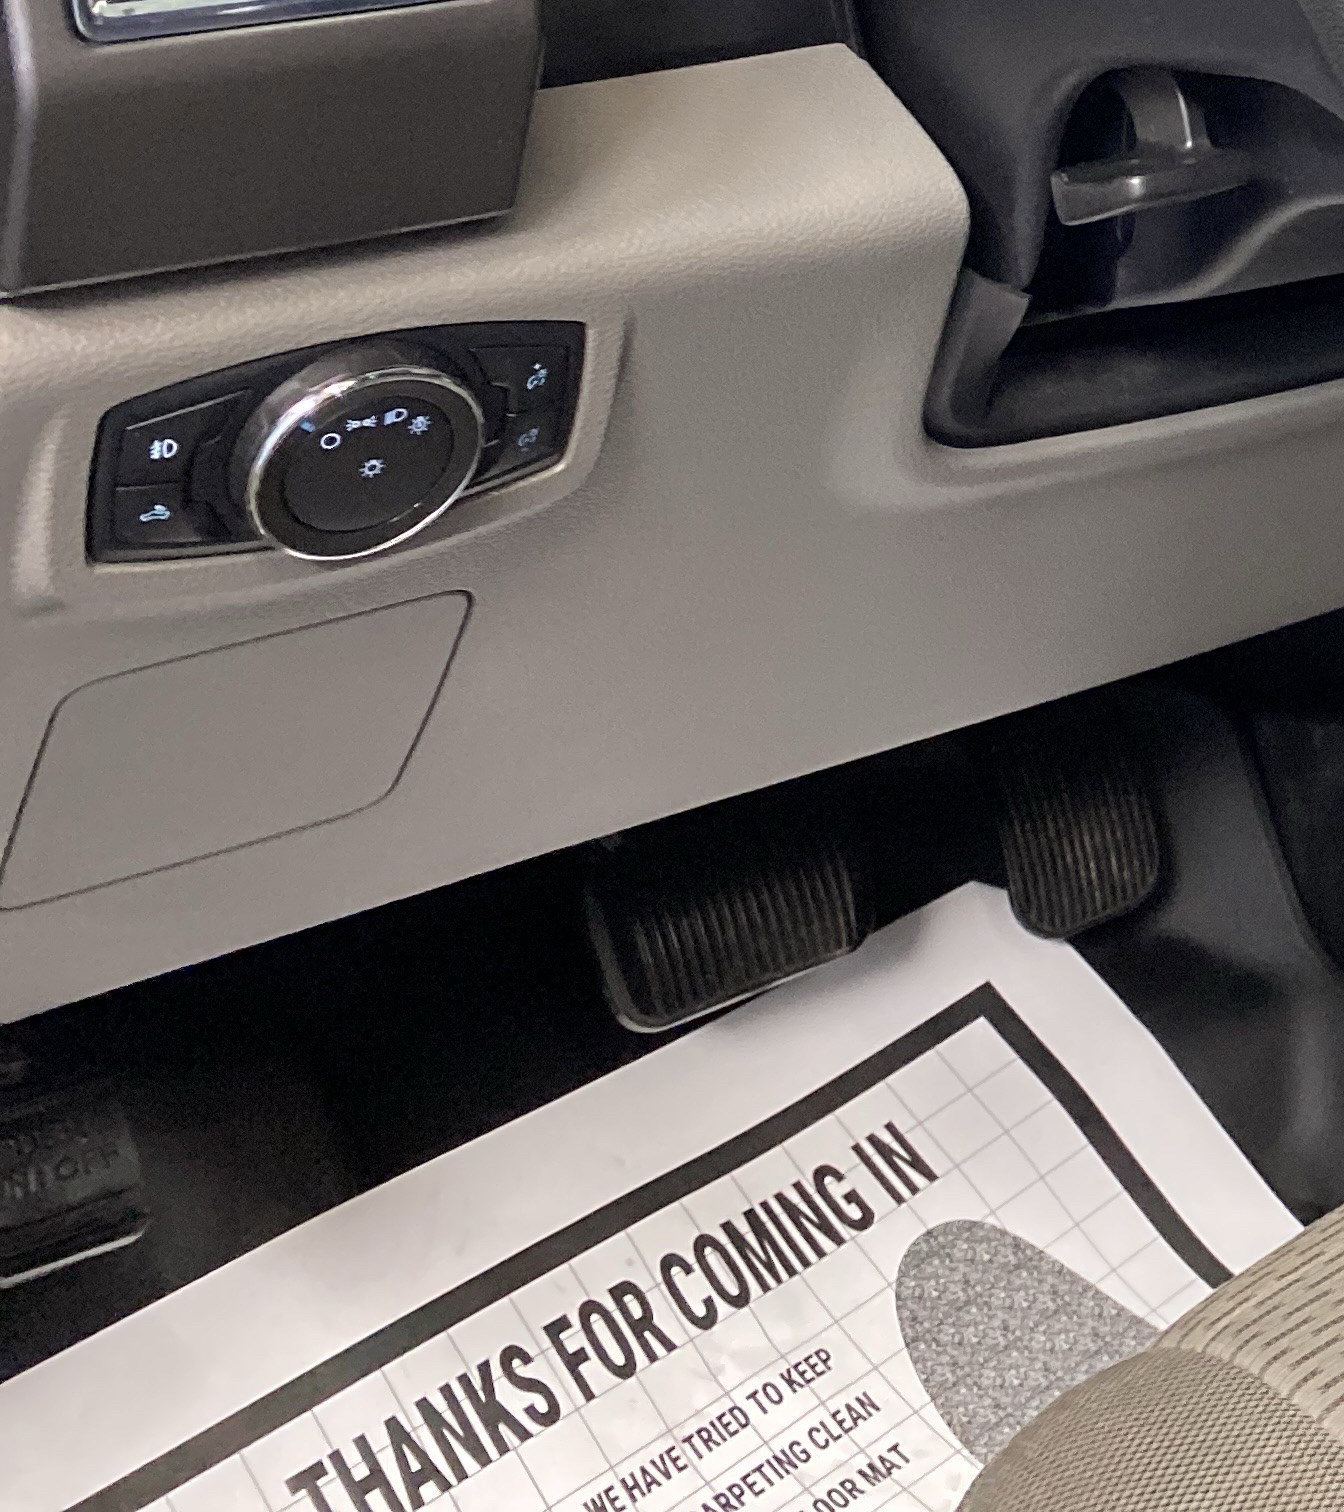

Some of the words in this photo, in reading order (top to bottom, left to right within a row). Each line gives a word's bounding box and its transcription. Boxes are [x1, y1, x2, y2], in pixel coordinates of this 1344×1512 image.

[284, 1342, 562, 1512] THANKS
[543, 1279, 678, 1402] FOR
[659, 1162, 875, 1331] COMING
[852, 1121, 939, 1206] IN
[583, 1485, 626, 1512] WE
[620, 1445, 688, 1503] HAVE
[682, 1404, 751, 1460] TRIED
[746, 1381, 784, 1415] TO
[779, 1347, 833, 1394] KEEP
[797, 1478, 866, 1512] OOR
[858, 1441, 911, 1487] MAT
[807, 1391, 881, 1451] CLEAN
